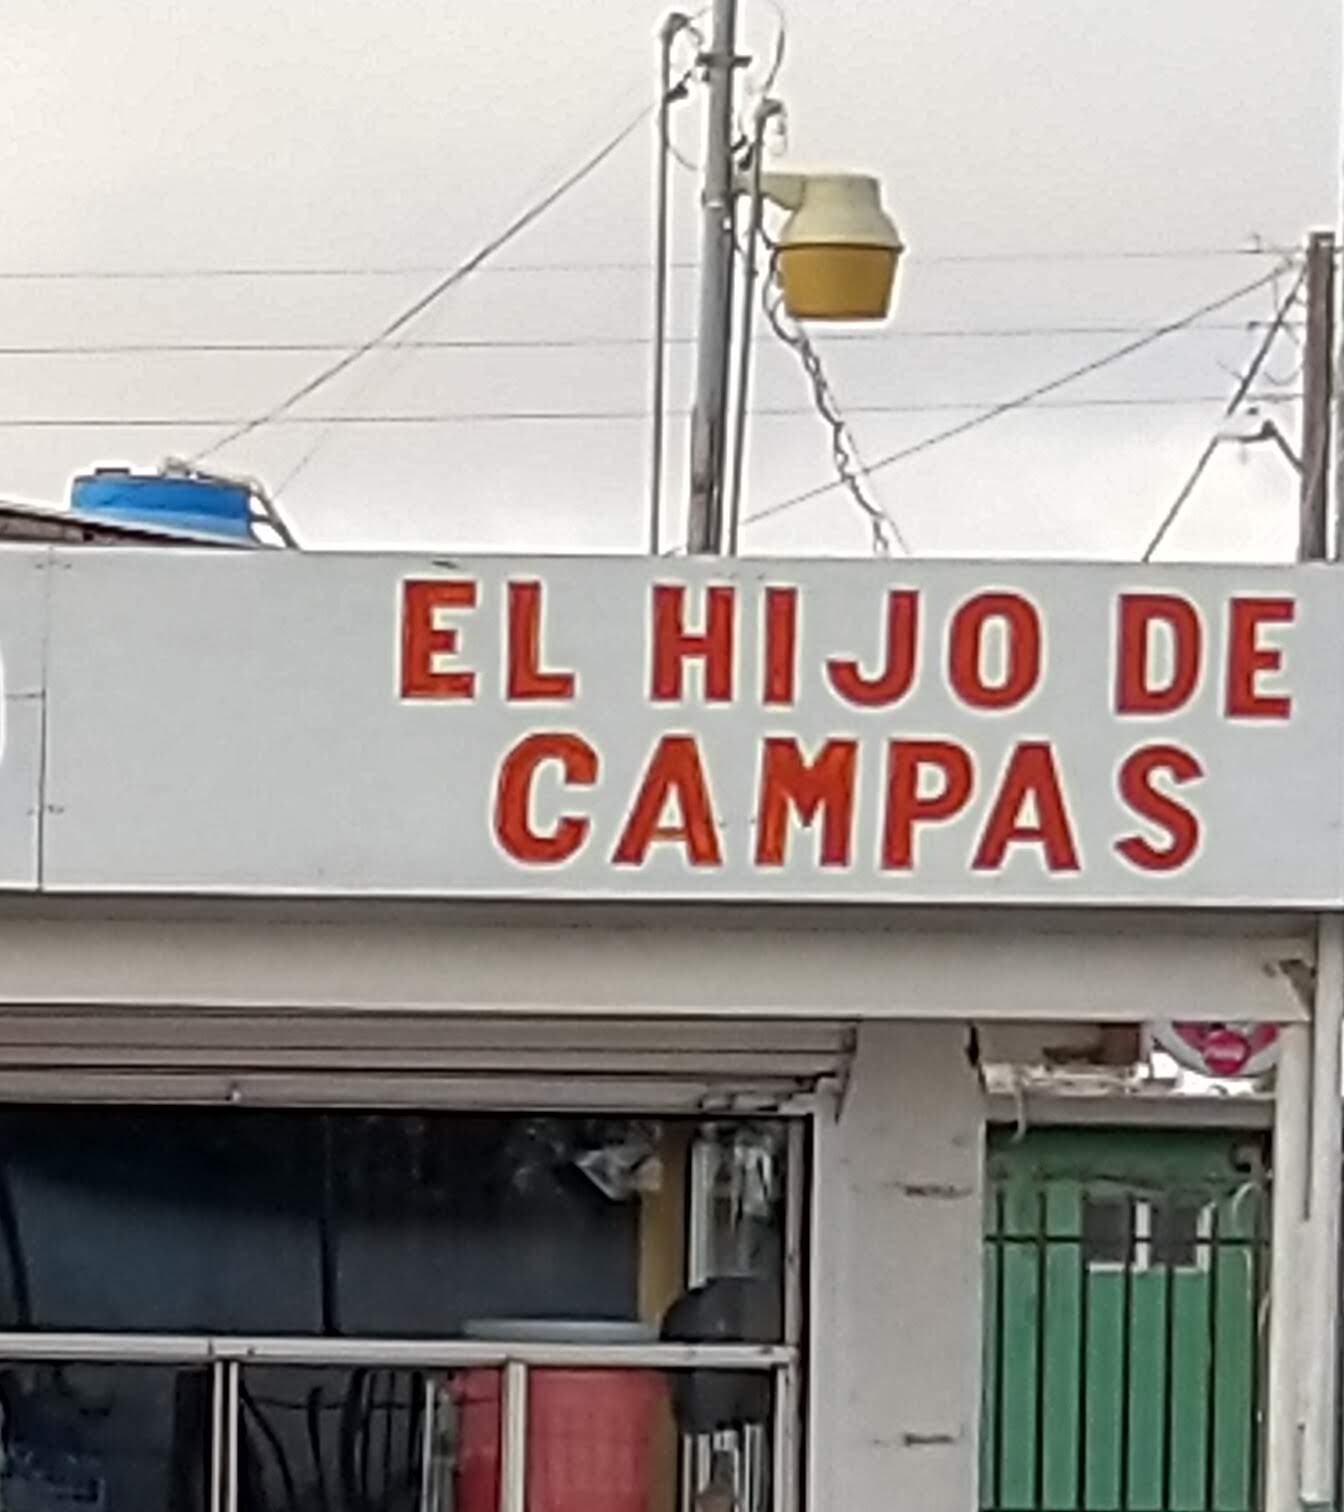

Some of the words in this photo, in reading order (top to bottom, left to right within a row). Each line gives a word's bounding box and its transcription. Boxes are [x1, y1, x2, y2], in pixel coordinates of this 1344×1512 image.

[398, 578, 577, 702] EL
[649, 584, 1042, 711] HIJO
[1113, 592, 1298, 720] DE
[492, 730, 1207, 873] CAMPAS
